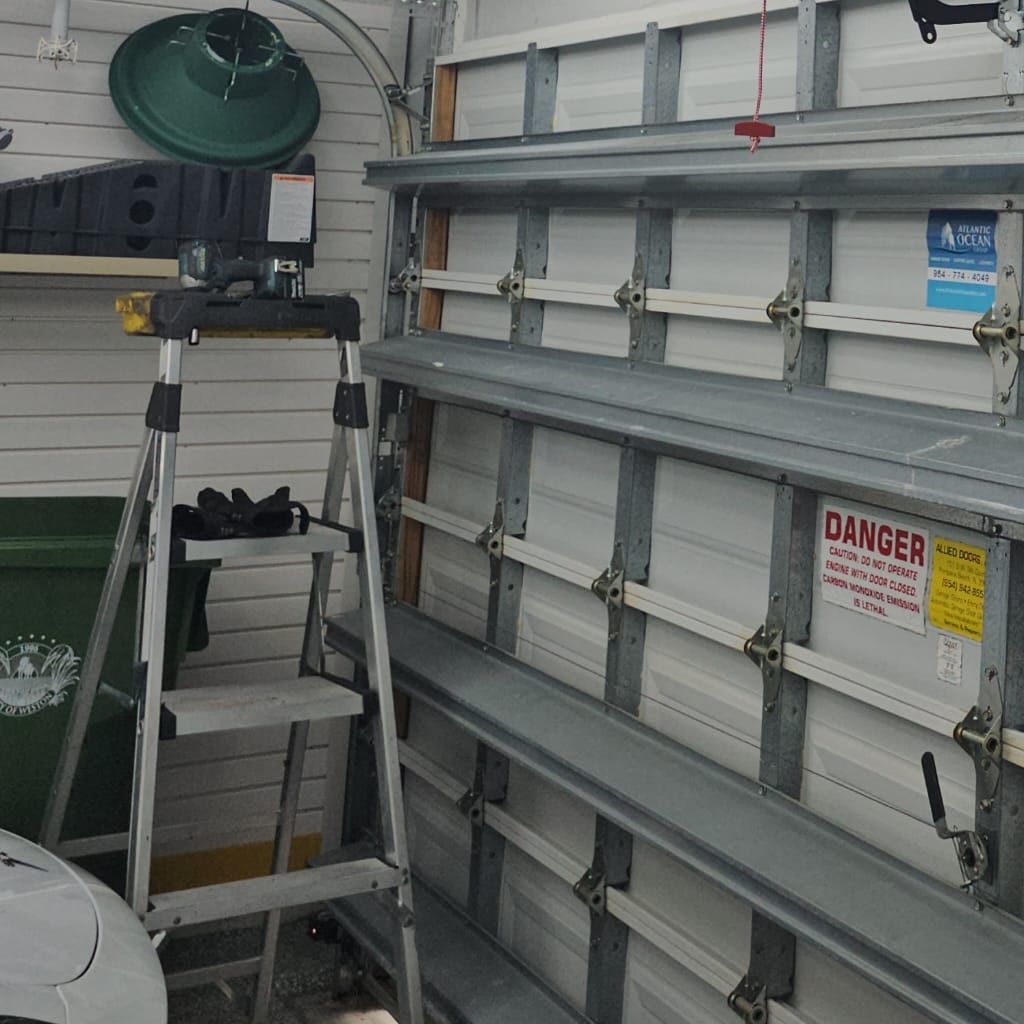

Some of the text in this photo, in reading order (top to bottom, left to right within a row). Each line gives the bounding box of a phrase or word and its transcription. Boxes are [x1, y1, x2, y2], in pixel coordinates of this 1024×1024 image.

[957, 225, 991, 234] ATLANTIC
[956, 233, 991, 248] OCEAN
[933, 269, 946, 278] 954
[952, 271, 965, 280] 774
[825, 510, 925, 567] DANGER
[936, 543, 981, 565] ALLIED DOORS
[825, 560, 849, 576] ENGINE
[851, 568, 867, 580] WITH
[869, 573, 888, 587] DOOR
[861, 555, 870, 566] DO
[872, 559, 886, 571] NOT
[888, 564, 918, 581] OPERATE
[822, 574, 920, 614] CARBON MONOXIDE EMISSION
[853, 597, 860, 608] IS
[19, 693, 54, 714] WESTON
